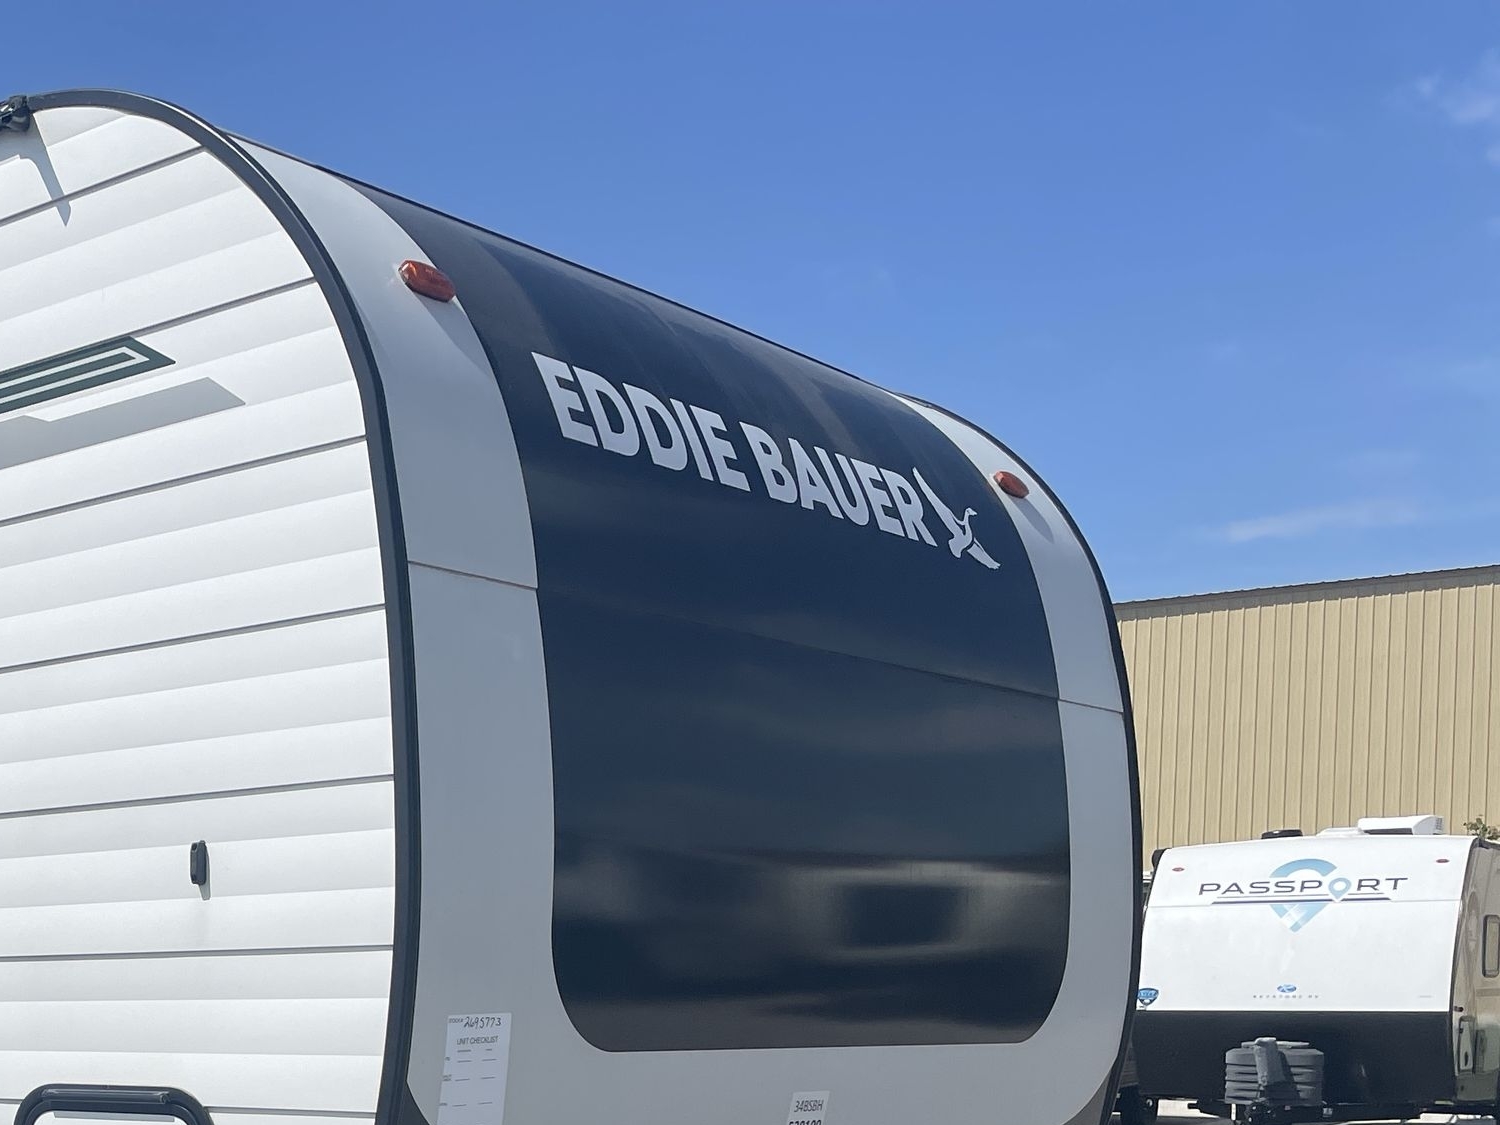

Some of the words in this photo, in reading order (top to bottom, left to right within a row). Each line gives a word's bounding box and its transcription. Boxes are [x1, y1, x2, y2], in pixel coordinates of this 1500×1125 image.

[531, 351, 751, 492] EDDIE
[738, 421, 938, 547] BAUER
[1198, 877, 1409, 899] PASSPORT
